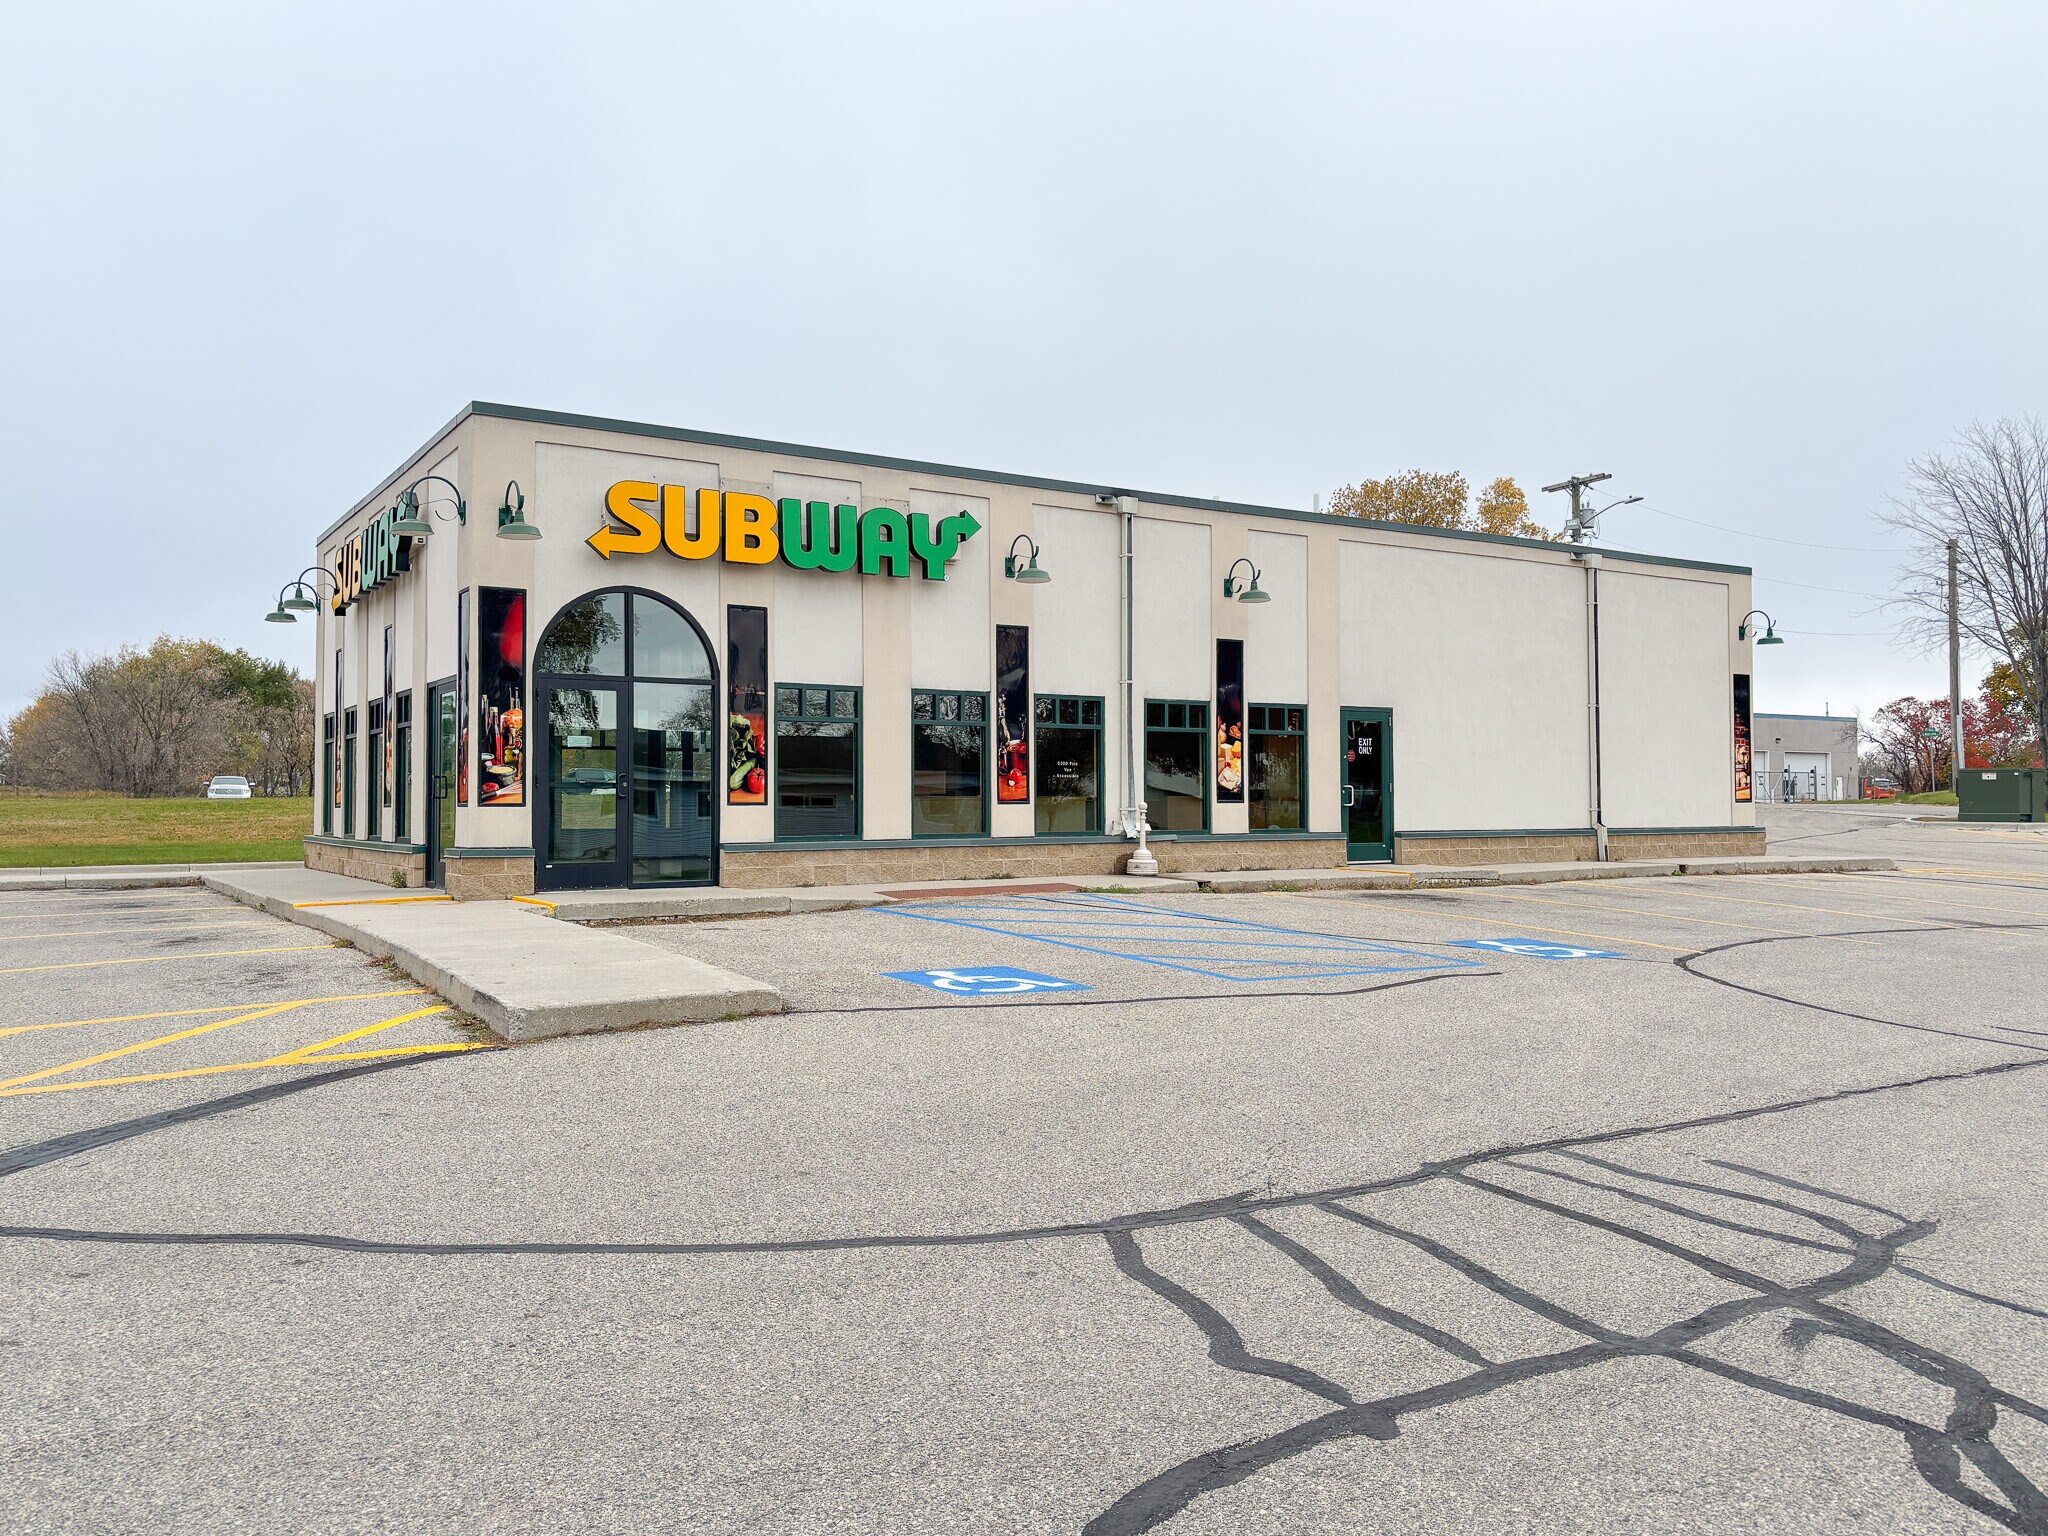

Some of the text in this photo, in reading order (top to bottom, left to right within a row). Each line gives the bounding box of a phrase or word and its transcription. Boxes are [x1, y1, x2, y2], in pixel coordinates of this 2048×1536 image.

[331, 497, 406, 609] SUBWAY
[586, 480, 982, 581] SUBWAY
[1358, 737, 1373, 746] EXIT
[1358, 746, 1373, 755] ONLY
